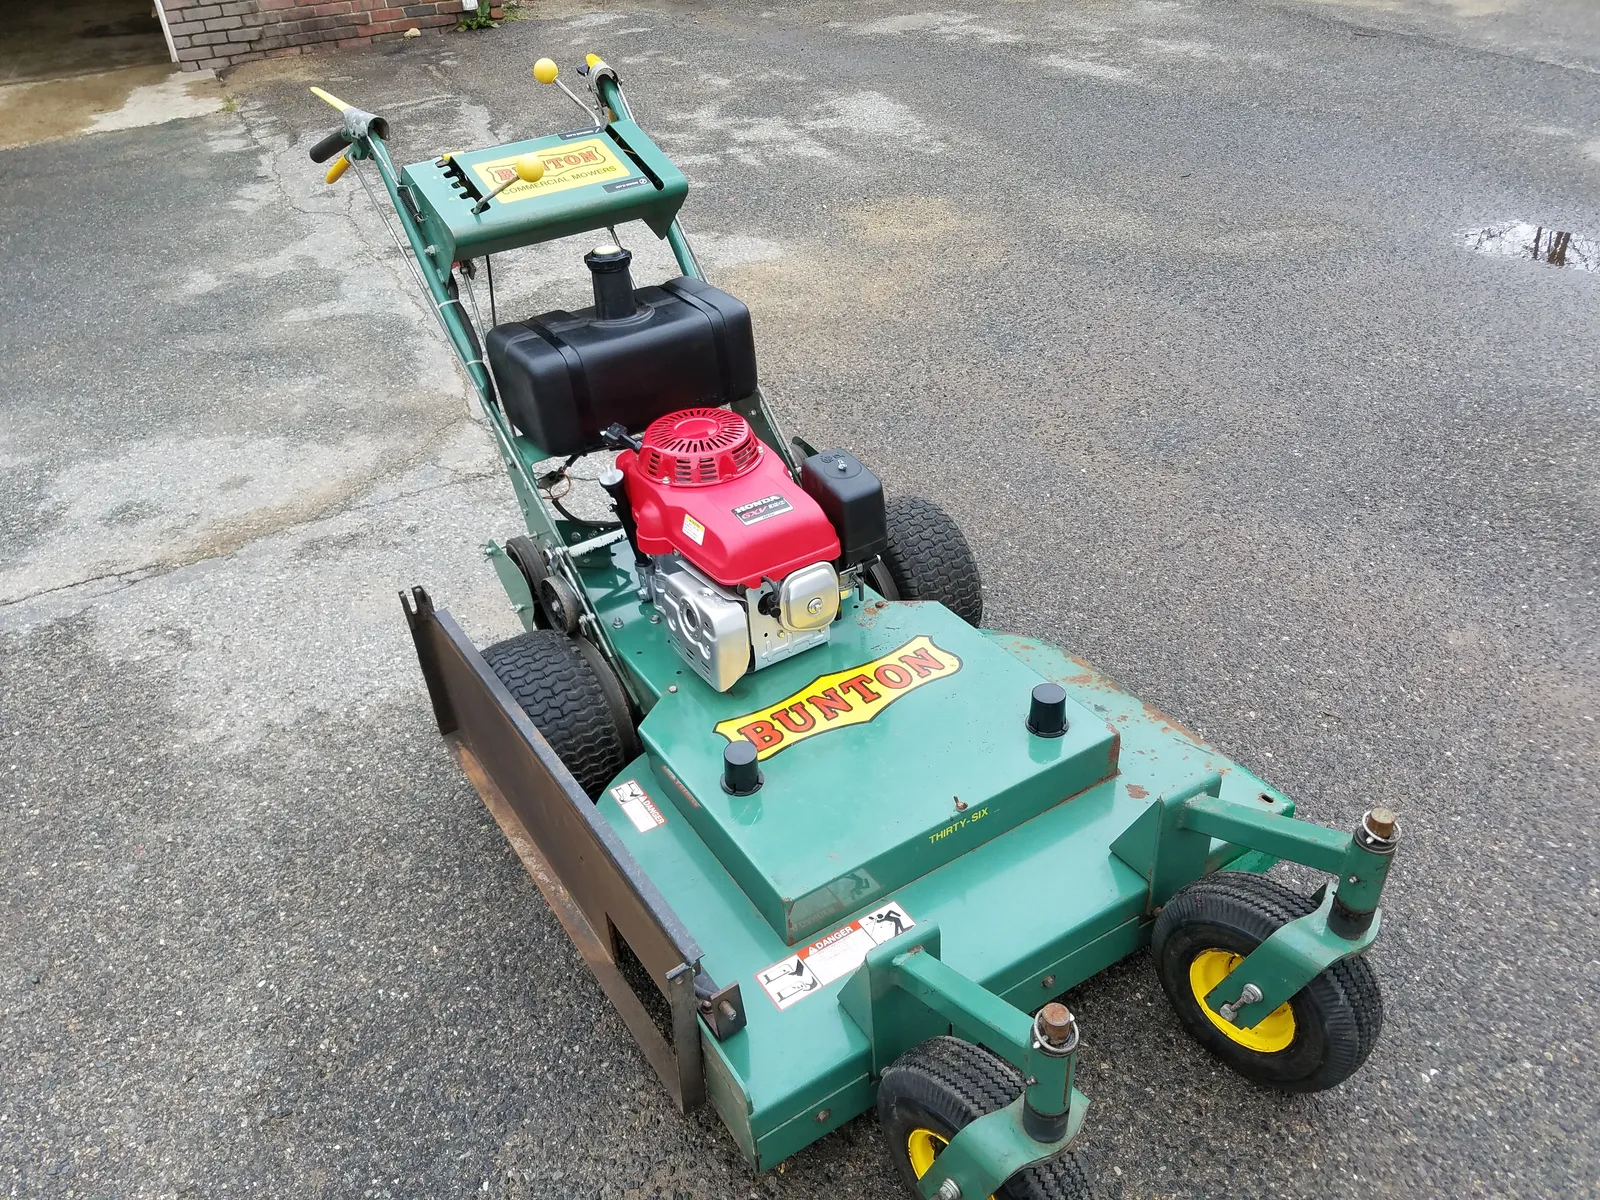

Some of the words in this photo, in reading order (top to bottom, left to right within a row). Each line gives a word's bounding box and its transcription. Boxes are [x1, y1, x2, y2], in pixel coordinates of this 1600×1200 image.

[494, 150, 598, 181] BTON
[502, 176, 571, 195] COMMERCIAL
[572, 165, 617, 180] MOWERS
[735, 495, 780, 513] HONDA
[738, 647, 945, 752] BUNTON
[642, 799, 665, 825] DANGER
[929, 807, 988, 844] THIRTY-SIX
[815, 926, 854, 951] DANGER
